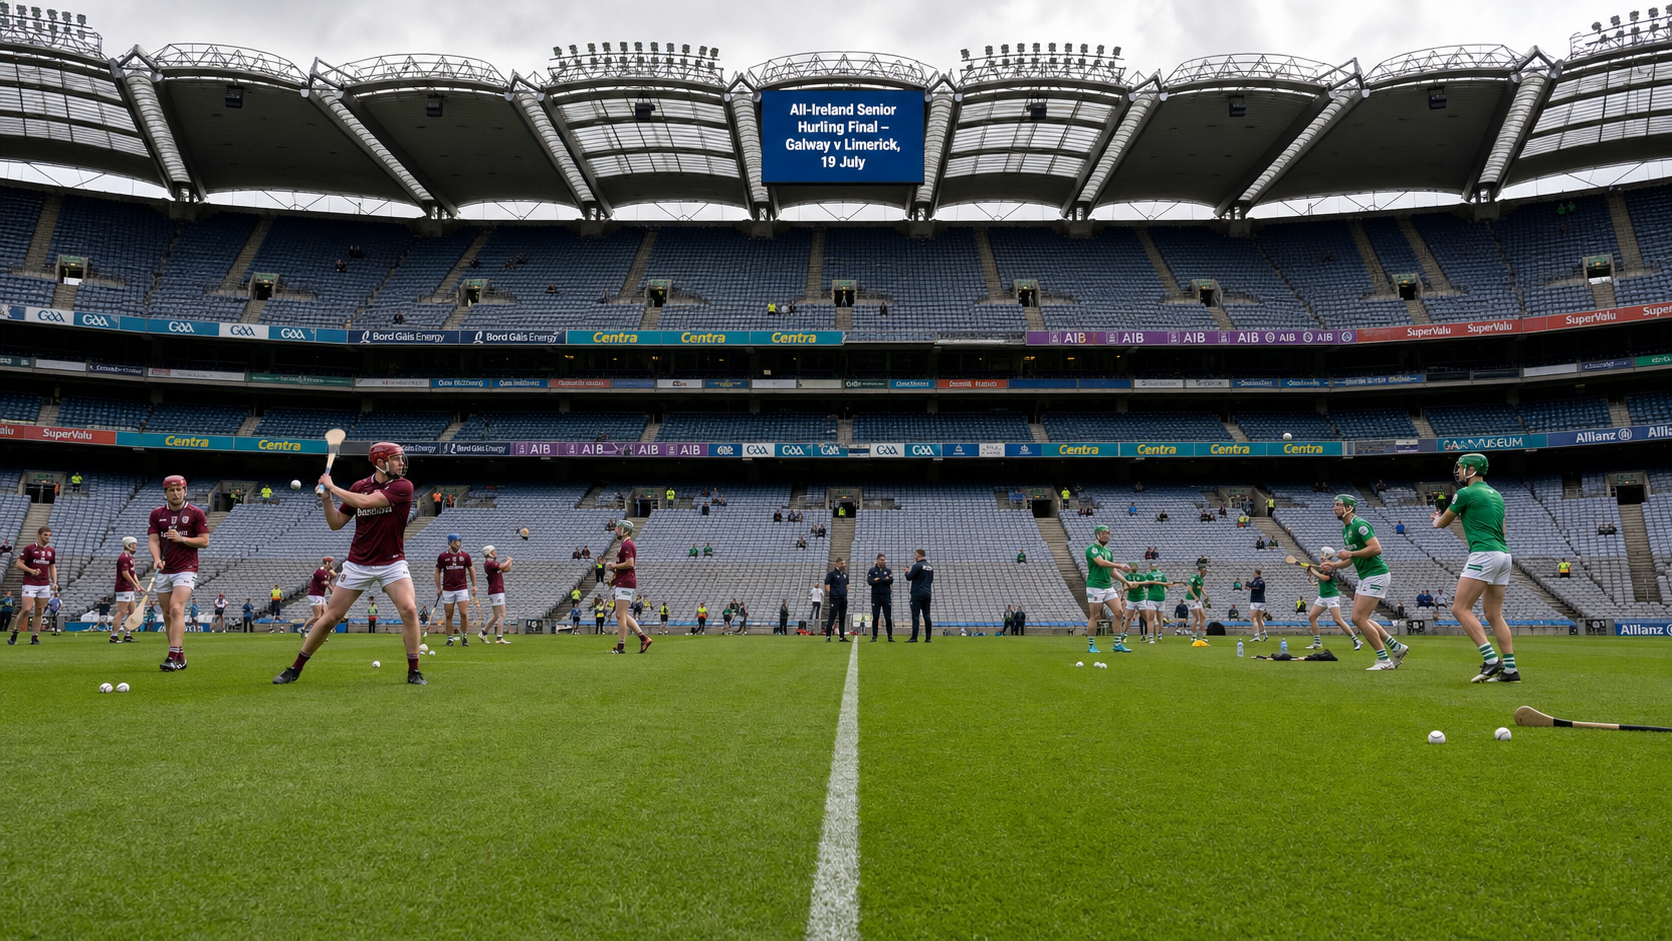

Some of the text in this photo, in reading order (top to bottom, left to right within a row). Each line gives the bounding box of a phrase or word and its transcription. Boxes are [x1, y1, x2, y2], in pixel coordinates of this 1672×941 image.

[790, 103, 897, 116] All-Ireland Senior
[798, 121, 845, 135] Hurling
[848, 121, 878, 133] Final
[785, 138, 900, 153] Galway v Limerick,
[821, 156, 866, 170] 19 July
[37, 309, 66, 323] GAA
[82, 314, 109, 327] GAA
[1565, 310, 1617, 326] SuperValu
[168, 321, 194, 333] GAA
[230, 325, 255, 337] GAA
[1407, 326, 1452, 338] SuperValu
[1467, 321, 1513, 334] SuperValu
[280, 328, 306, 340] GAA
[373, 332, 395, 341] Bord
[416, 332, 445, 343] Energy
[486, 332, 508, 341] Bord
[529, 332, 558, 343] Energy
[593, 332, 638, 343] Centra
[681, 332, 726, 343] Centra
[771, 332, 817, 343] Centra
[1064, 332, 1087, 343] AIB
[1122, 333, 1145, 343] AIB
[1183, 333, 1206, 343] AIB
[1237, 332, 1259, 343] AIB
[1279, 333, 1296, 342] AIB
[1317, 333, 1333, 342] AIB
[42, 428, 92, 440] SuperValu
[1575, 430, 1616, 444] Allianz
[165, 435, 209, 447] Centra
[258, 440, 301, 451] Centra
[530, 444, 551, 454] AIB
[582, 444, 604, 454] AIB
[638, 445, 659, 454] AIB
[680, 445, 701, 454] AIB
[746, 444, 769, 455] GAA
[782, 444, 805, 456] GAA
[876, 445, 898, 455] GAA
[912, 445, 934, 456] GAA
[1059, 444, 1099, 455] Centra
[1136, 444, 1176, 455] Centra
[1210, 443, 1250, 454] Centra
[1283, 443, 1323, 454] Centra
[1620, 624, 1664, 636] Allianz
